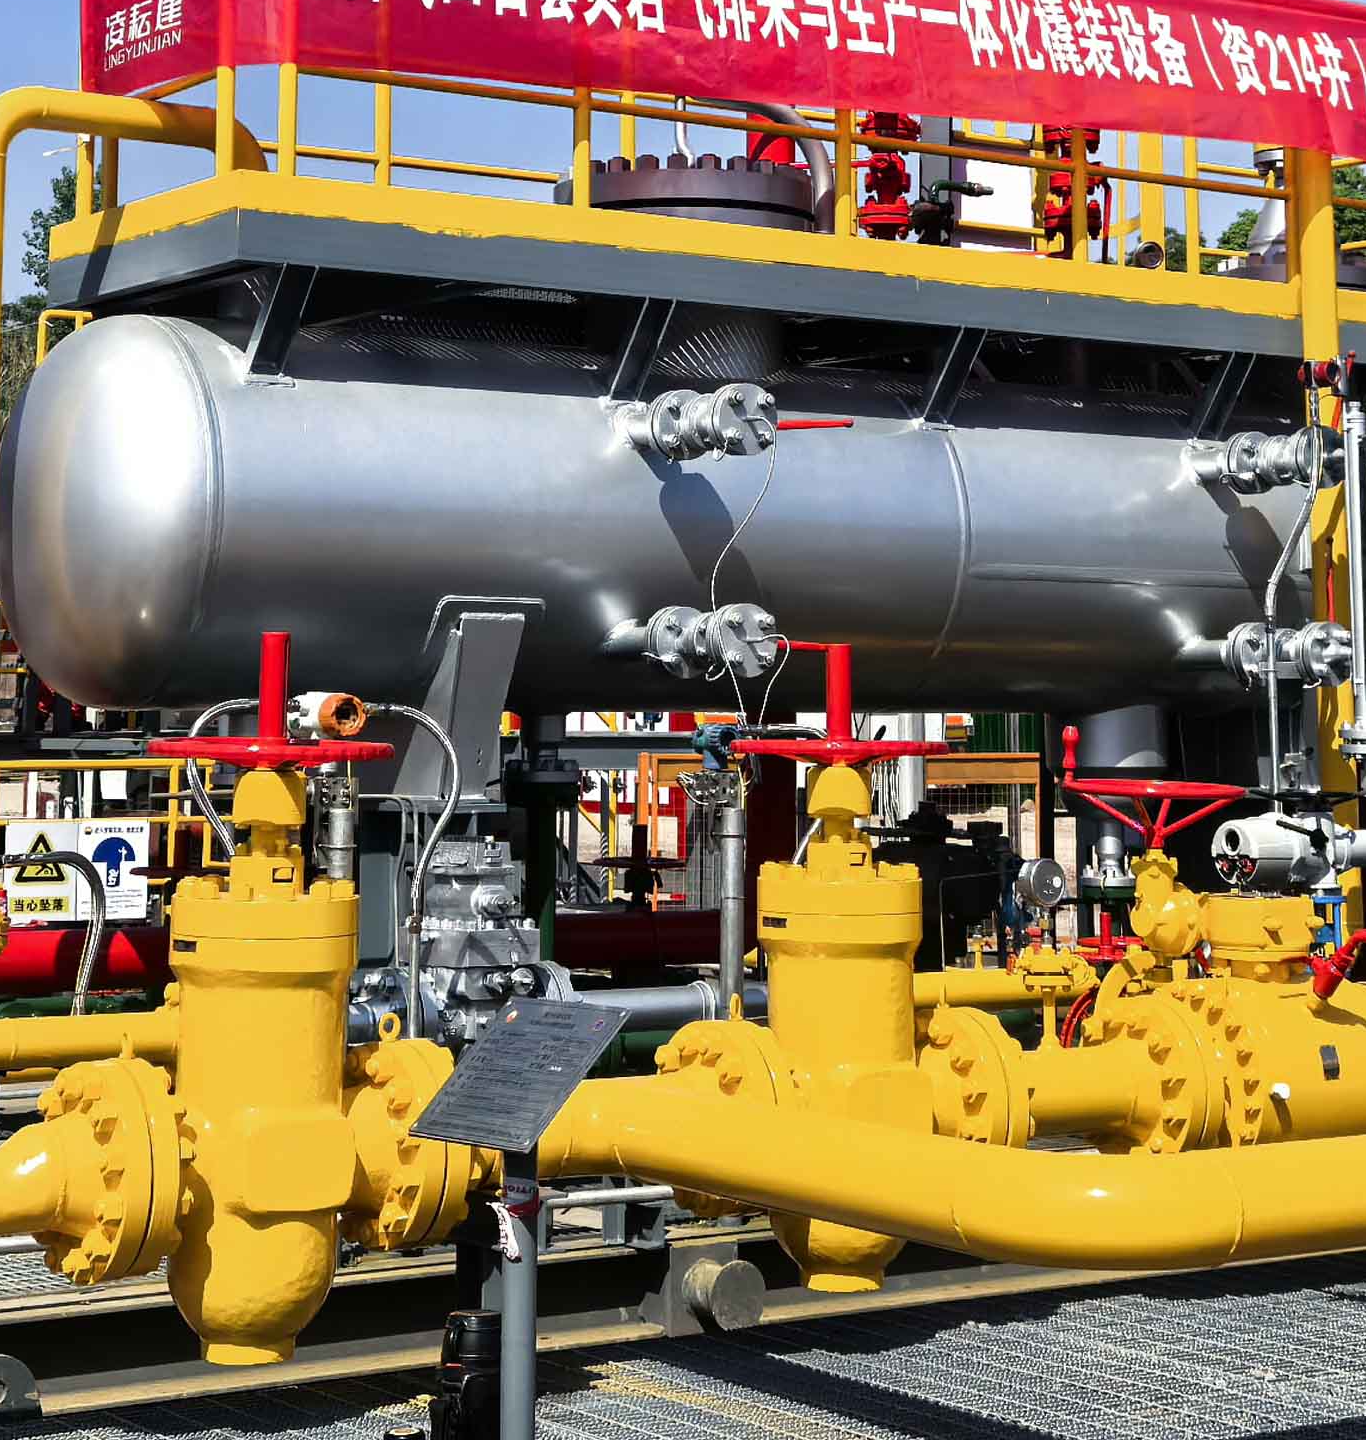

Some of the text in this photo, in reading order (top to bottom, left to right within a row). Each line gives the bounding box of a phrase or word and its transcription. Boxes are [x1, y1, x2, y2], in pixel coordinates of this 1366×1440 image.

[104, 28, 182, 72] LINGYUNJIAN
[13, 898, 63, 912] 当心坠落
